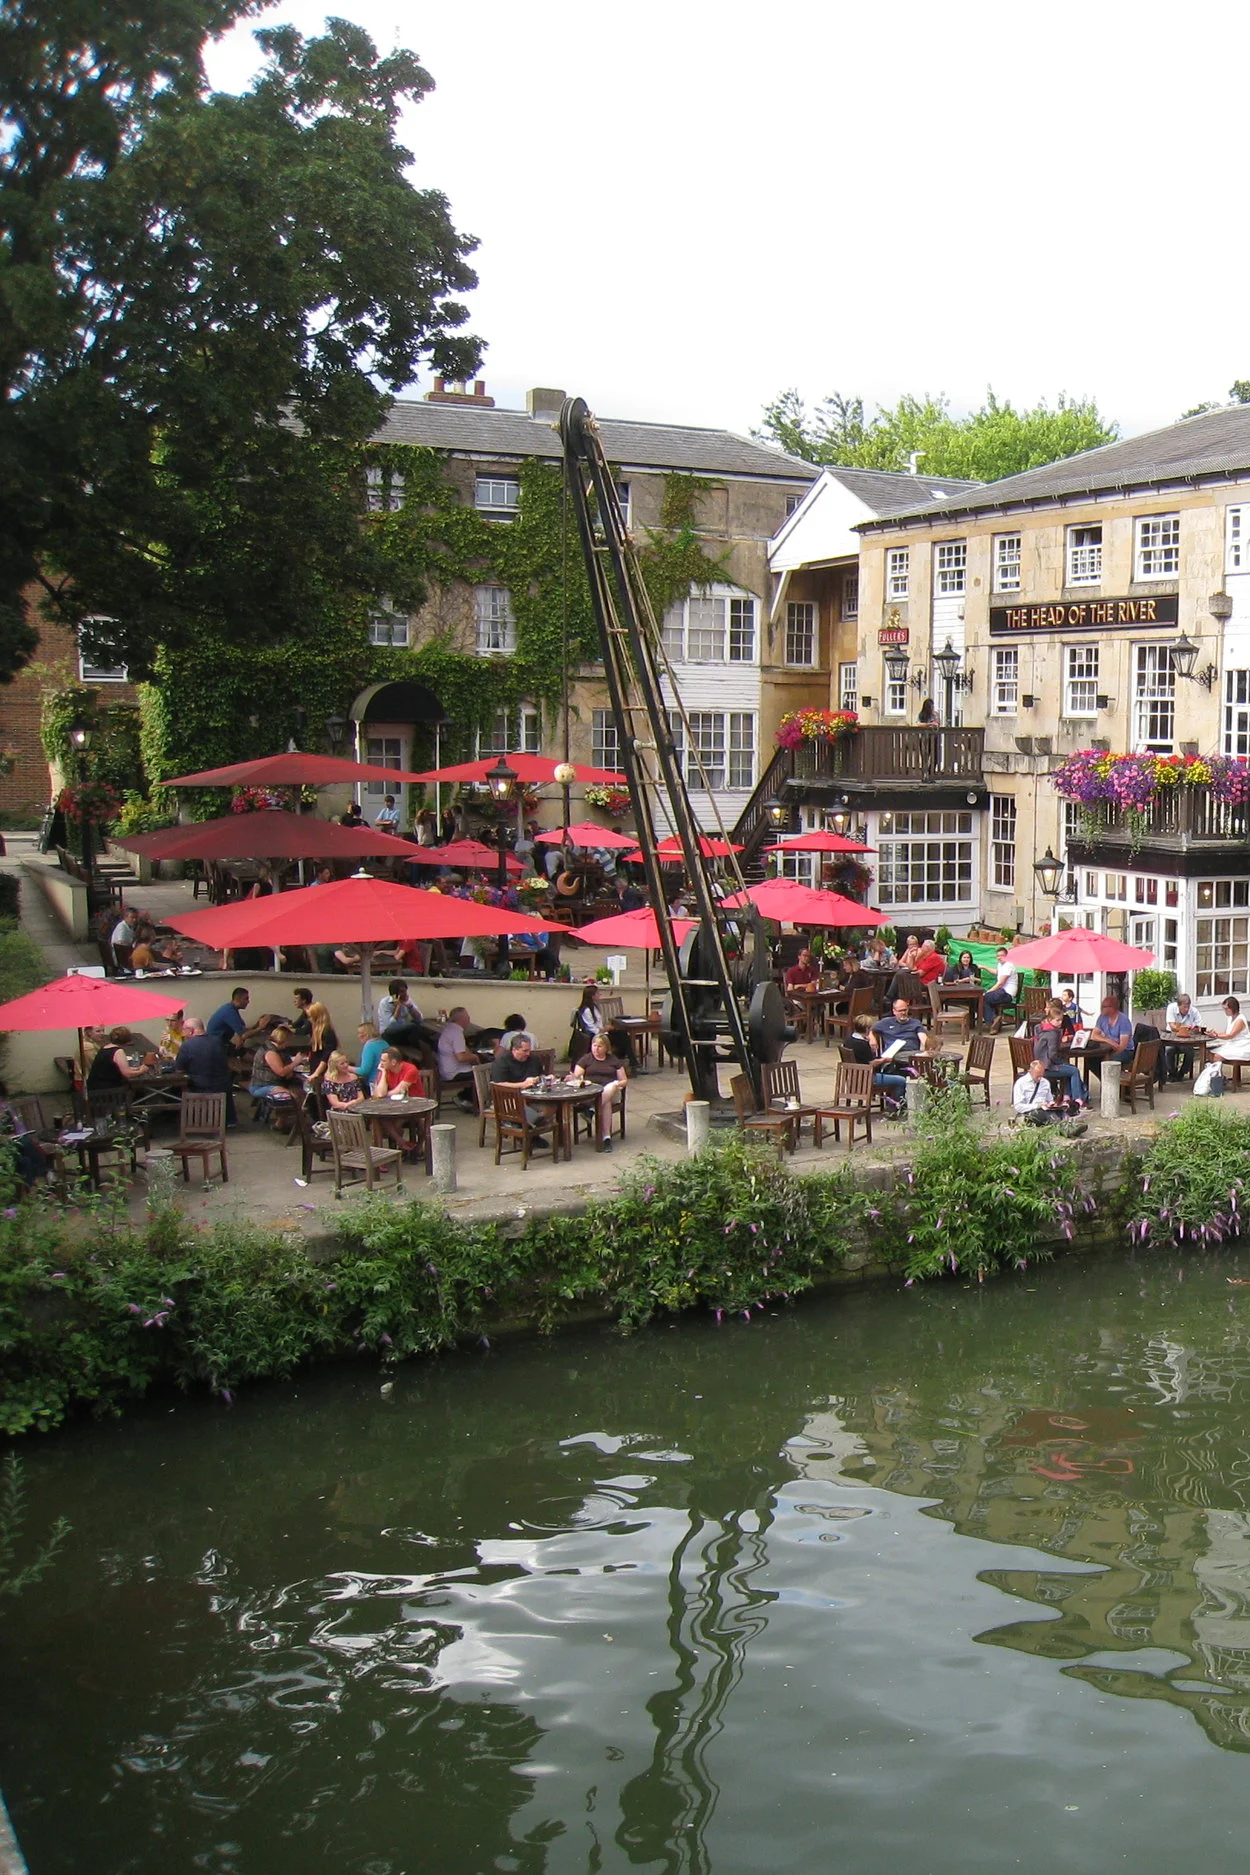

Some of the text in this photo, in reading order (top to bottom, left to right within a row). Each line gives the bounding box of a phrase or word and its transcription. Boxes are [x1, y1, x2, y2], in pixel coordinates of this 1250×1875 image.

[1005, 600, 1157, 628] THE HEAD OF THE RIVER
[879, 630, 906, 641] FULLER'S
